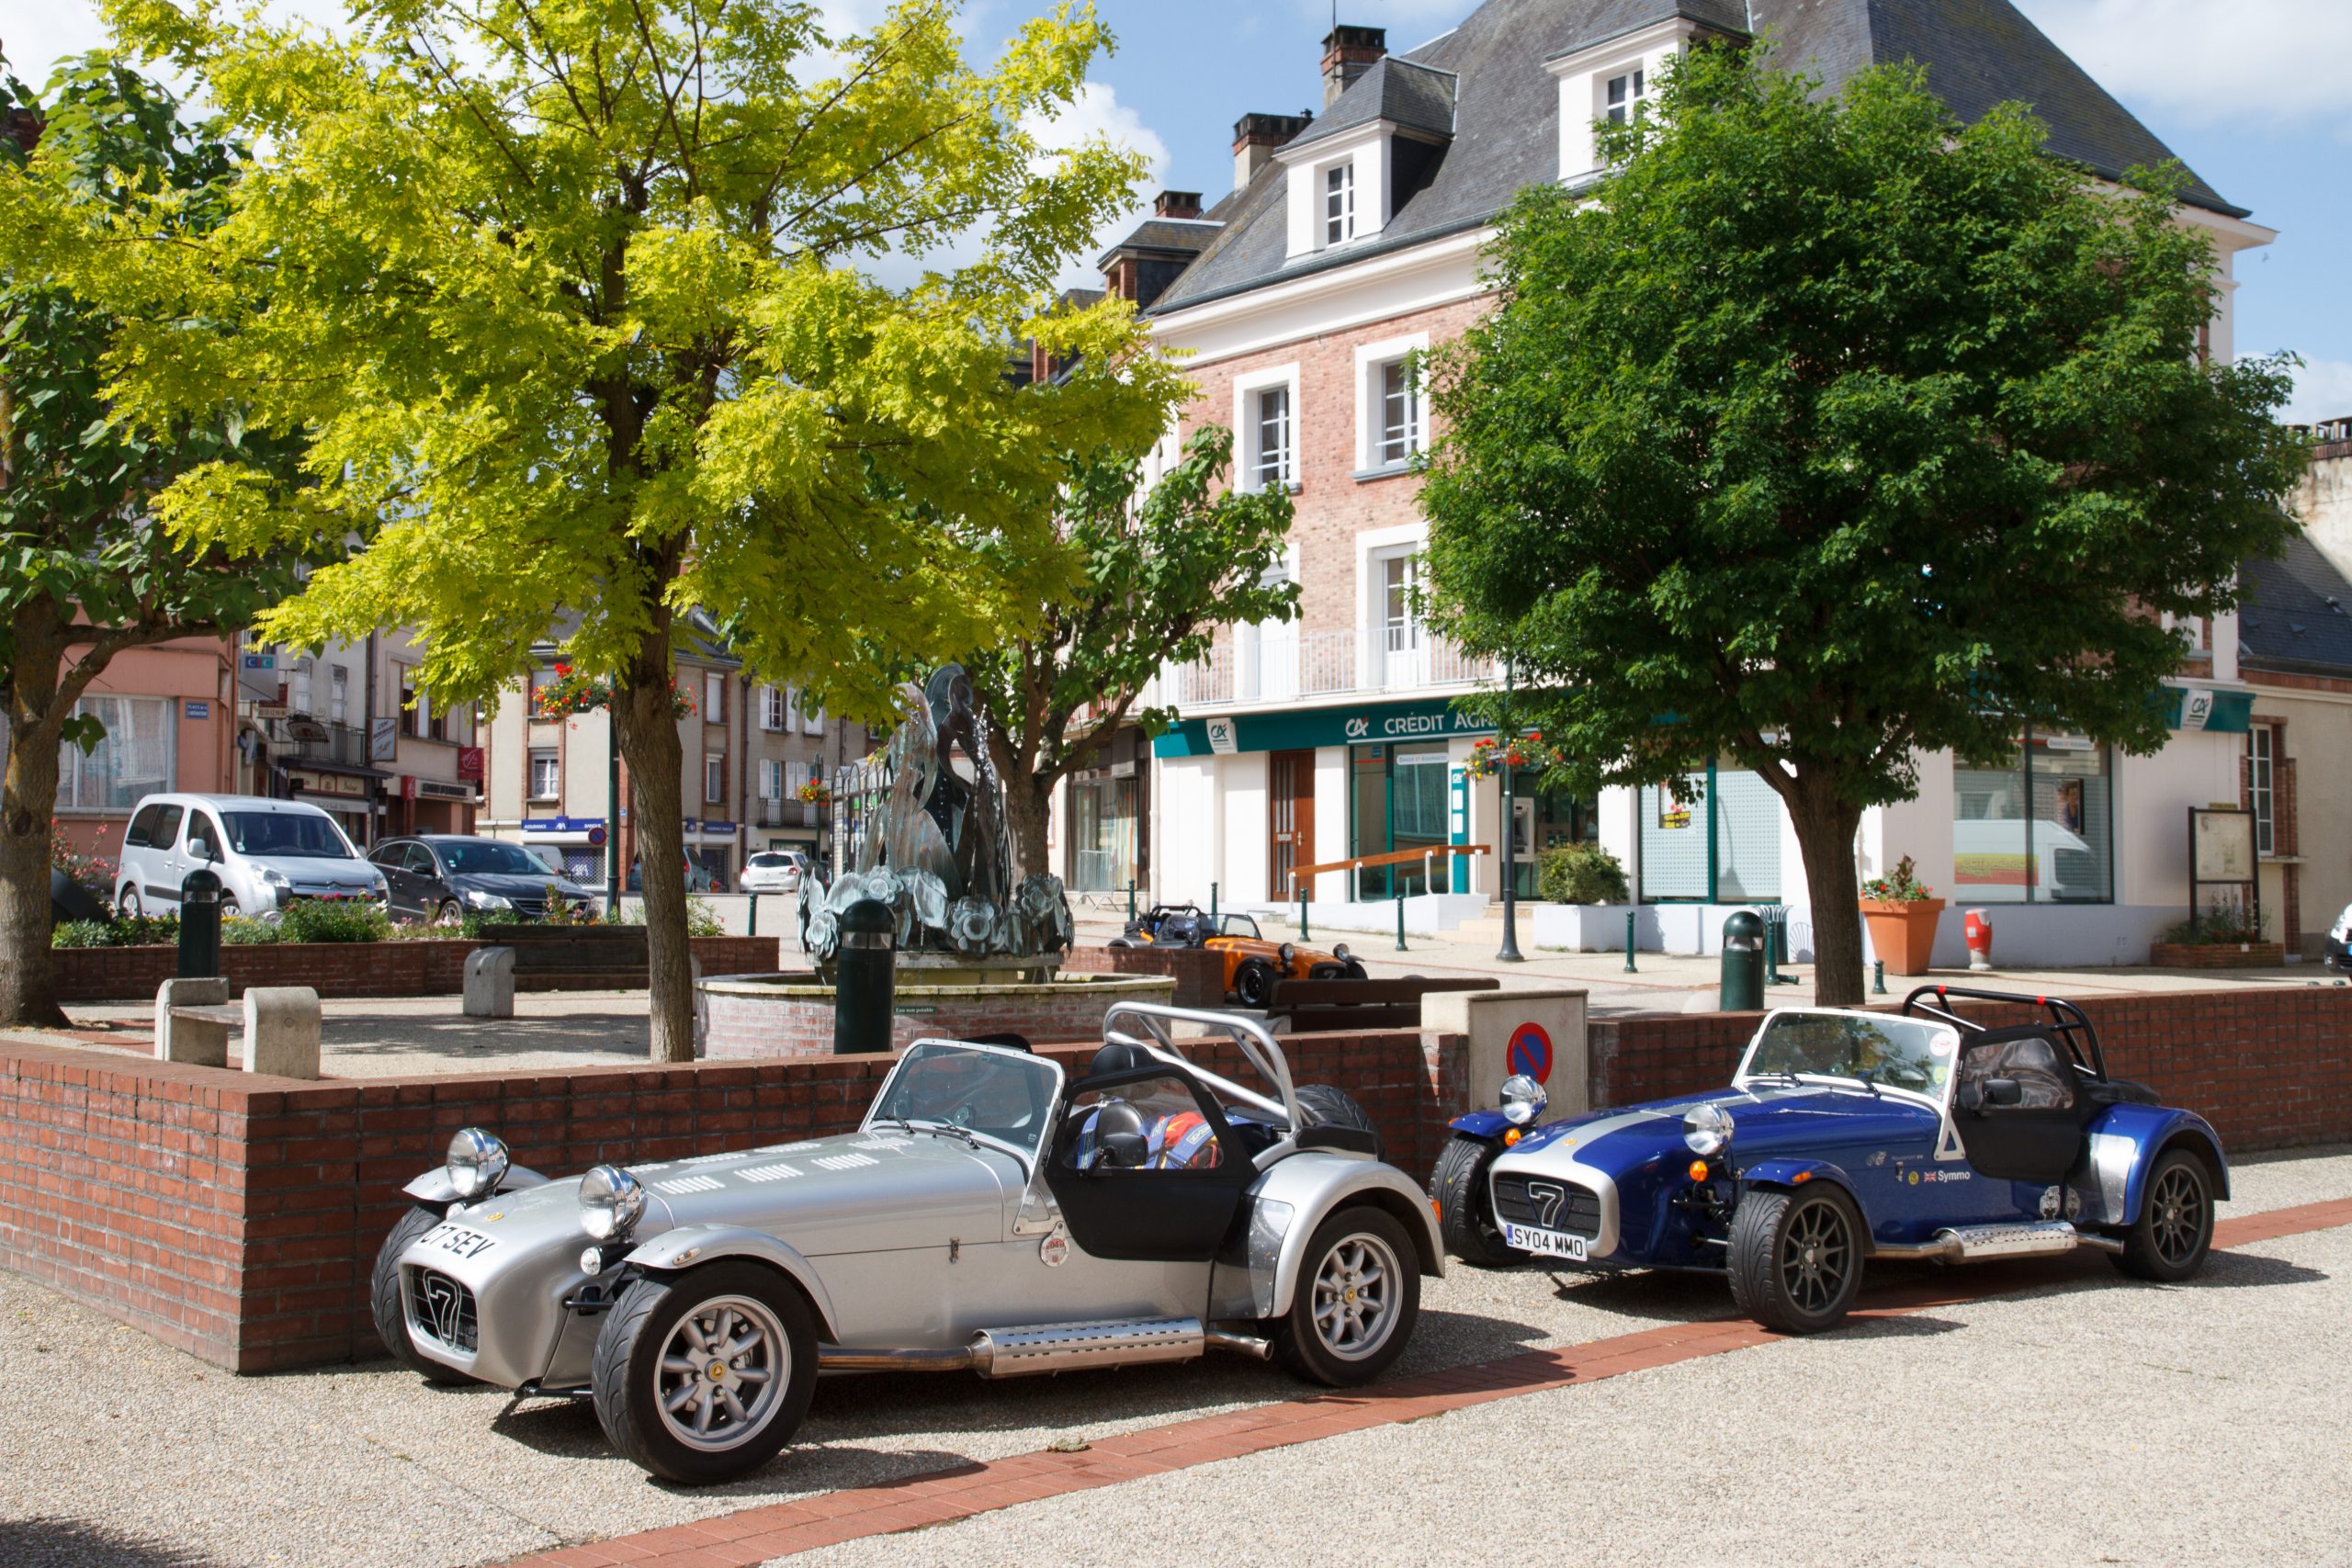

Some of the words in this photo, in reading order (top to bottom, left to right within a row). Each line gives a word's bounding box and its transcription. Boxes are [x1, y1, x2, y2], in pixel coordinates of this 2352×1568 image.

[247, 658, 273, 667] CIC
[1385, 712, 1444, 734] CRÉDIT
[1938, 1169, 1971, 1183] Symmo
[1529, 1181, 1564, 1228] 7
[443, 1231, 495, 1258] SEV
[1514, 1228, 1550, 1250] SY04
[1555, 1235, 1583, 1257] MMO
[427, 1276, 458, 1339] 7
